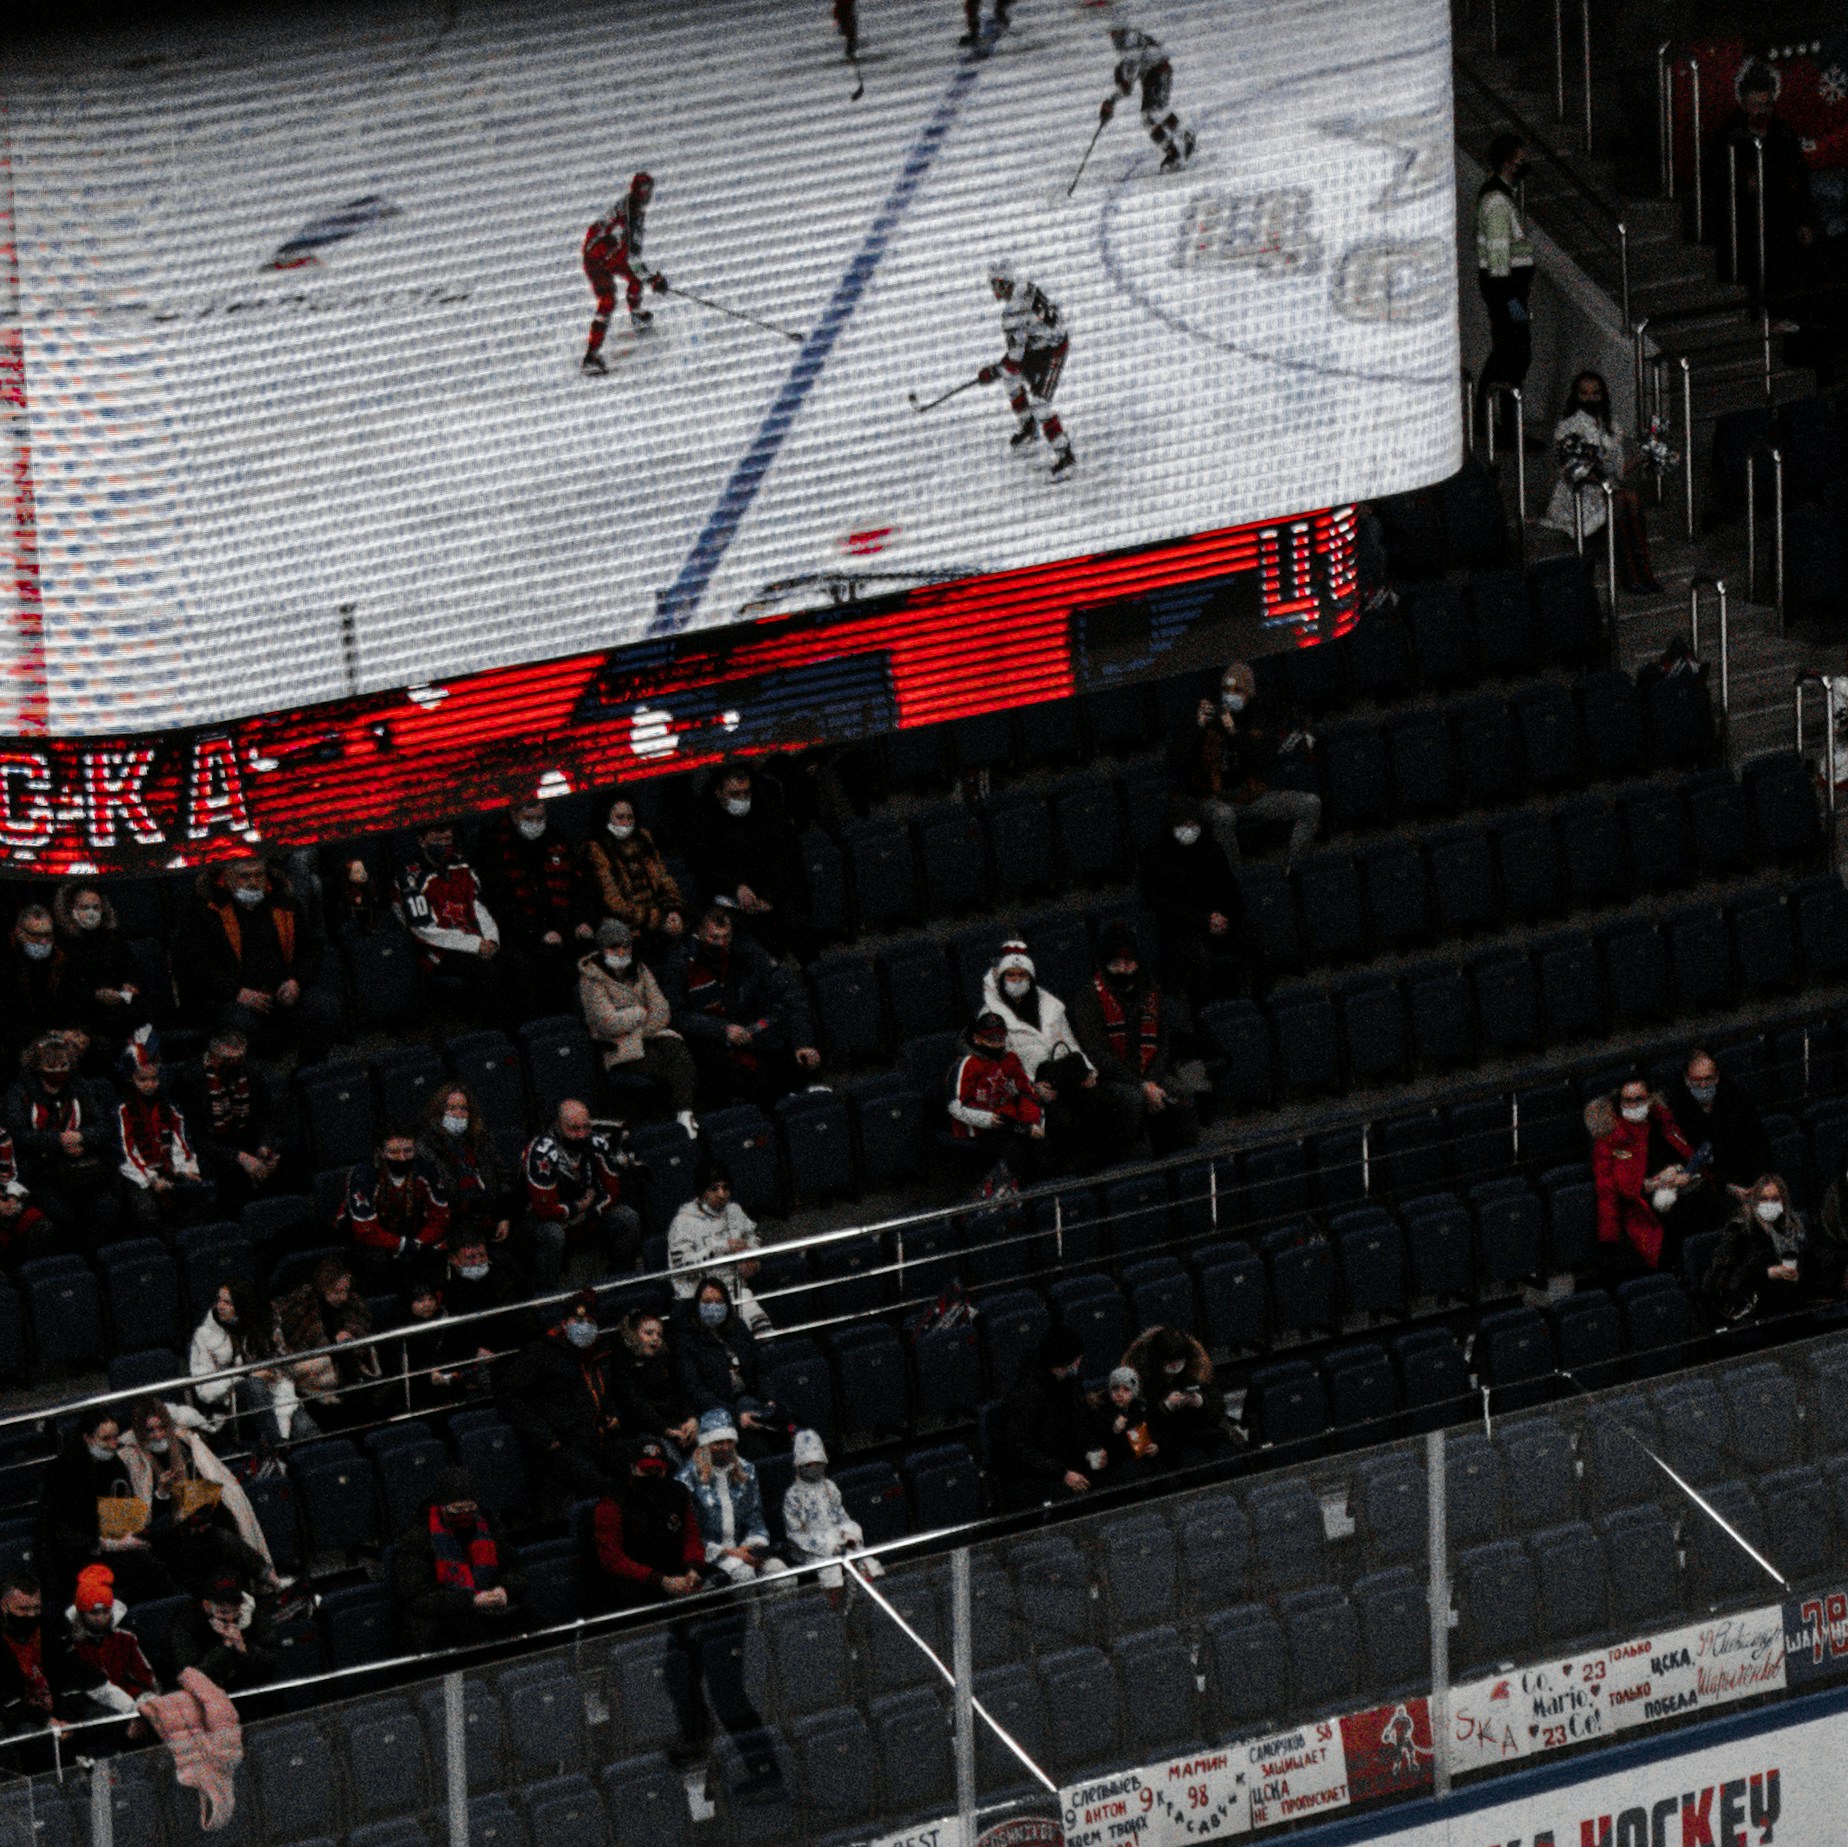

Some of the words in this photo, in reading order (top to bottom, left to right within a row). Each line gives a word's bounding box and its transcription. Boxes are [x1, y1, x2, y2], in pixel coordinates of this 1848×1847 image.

[1608, 1640, 1653, 1664] ТОЛЬКО
[1582, 1660, 1607, 1683] 23
[1609, 1681, 1653, 1707] ТОЛЬКО
[1644, 1689, 1699, 1719] ПОБЕДА
[1542, 1724, 1567, 1748] 23
[1168, 1754, 1229, 1780] МАМИН
[1084, 1802, 1127, 1826] АНТОН
[1139, 1787, 1154, 1813] 9
[1187, 1784, 1209, 1810] 98
[1254, 1806, 1269, 1824] НЕ
[1281, 1784, 1348, 1816] ПРОПУСКАЕТ
